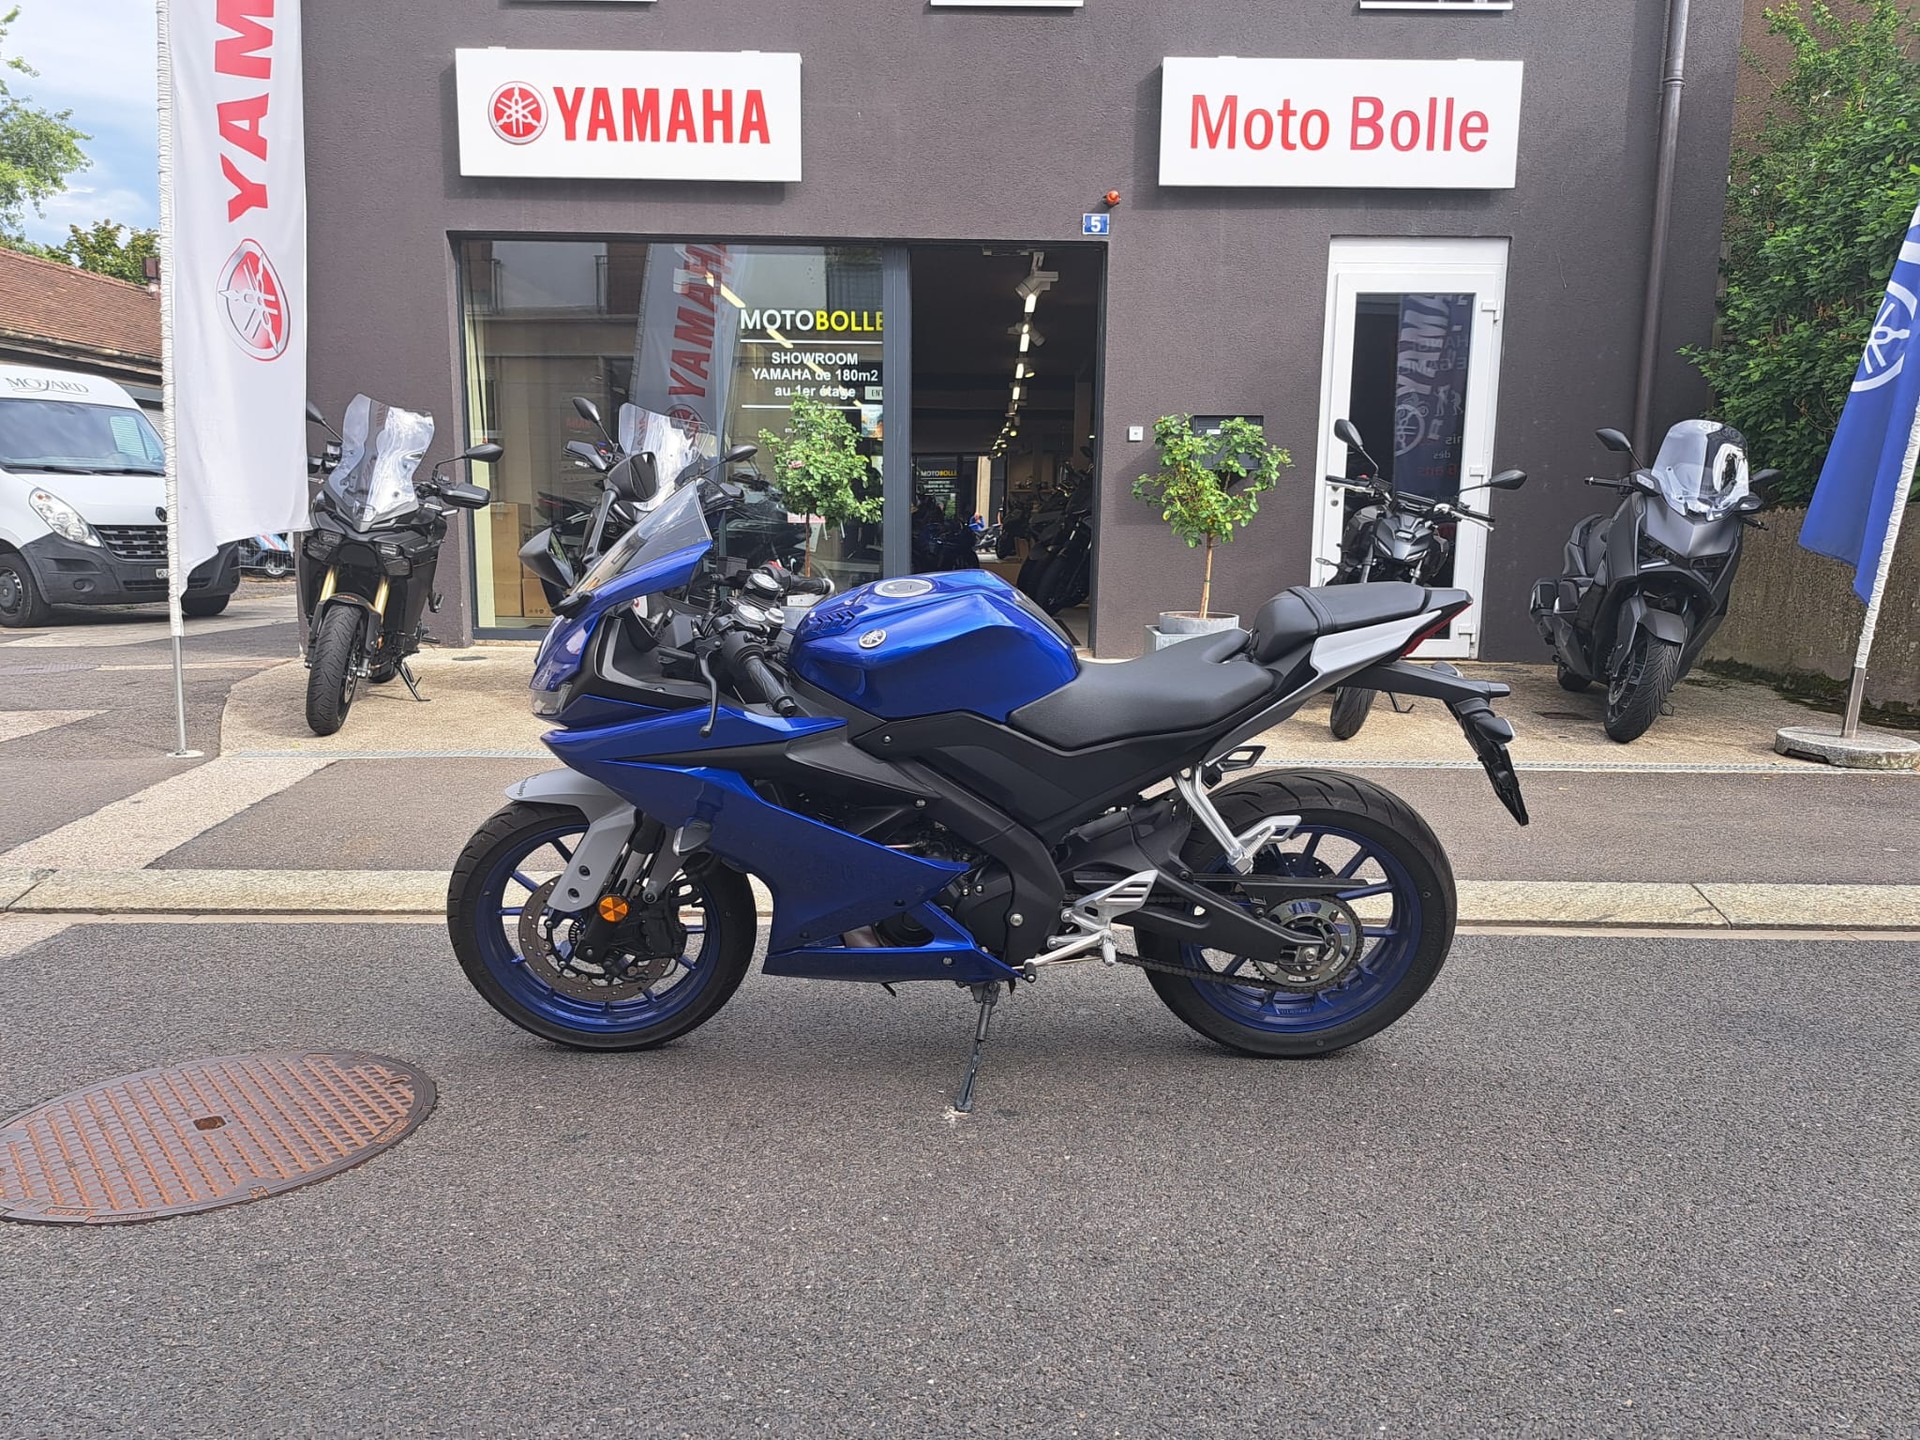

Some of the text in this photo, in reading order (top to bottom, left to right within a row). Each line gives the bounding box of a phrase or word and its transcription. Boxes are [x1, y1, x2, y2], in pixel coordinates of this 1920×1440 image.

[553, 86, 771, 144] YAMAHA
[1190, 94, 1489, 152] Moto Bolle
[1090, 216, 1102, 232] 5
[771, 352, 858, 365] SHOWROOM
[752, 368, 879, 381] YAMAHA de 180m2
[6, 377, 89, 395] MOYARD
[774, 384, 856, 400] au 1er étage
